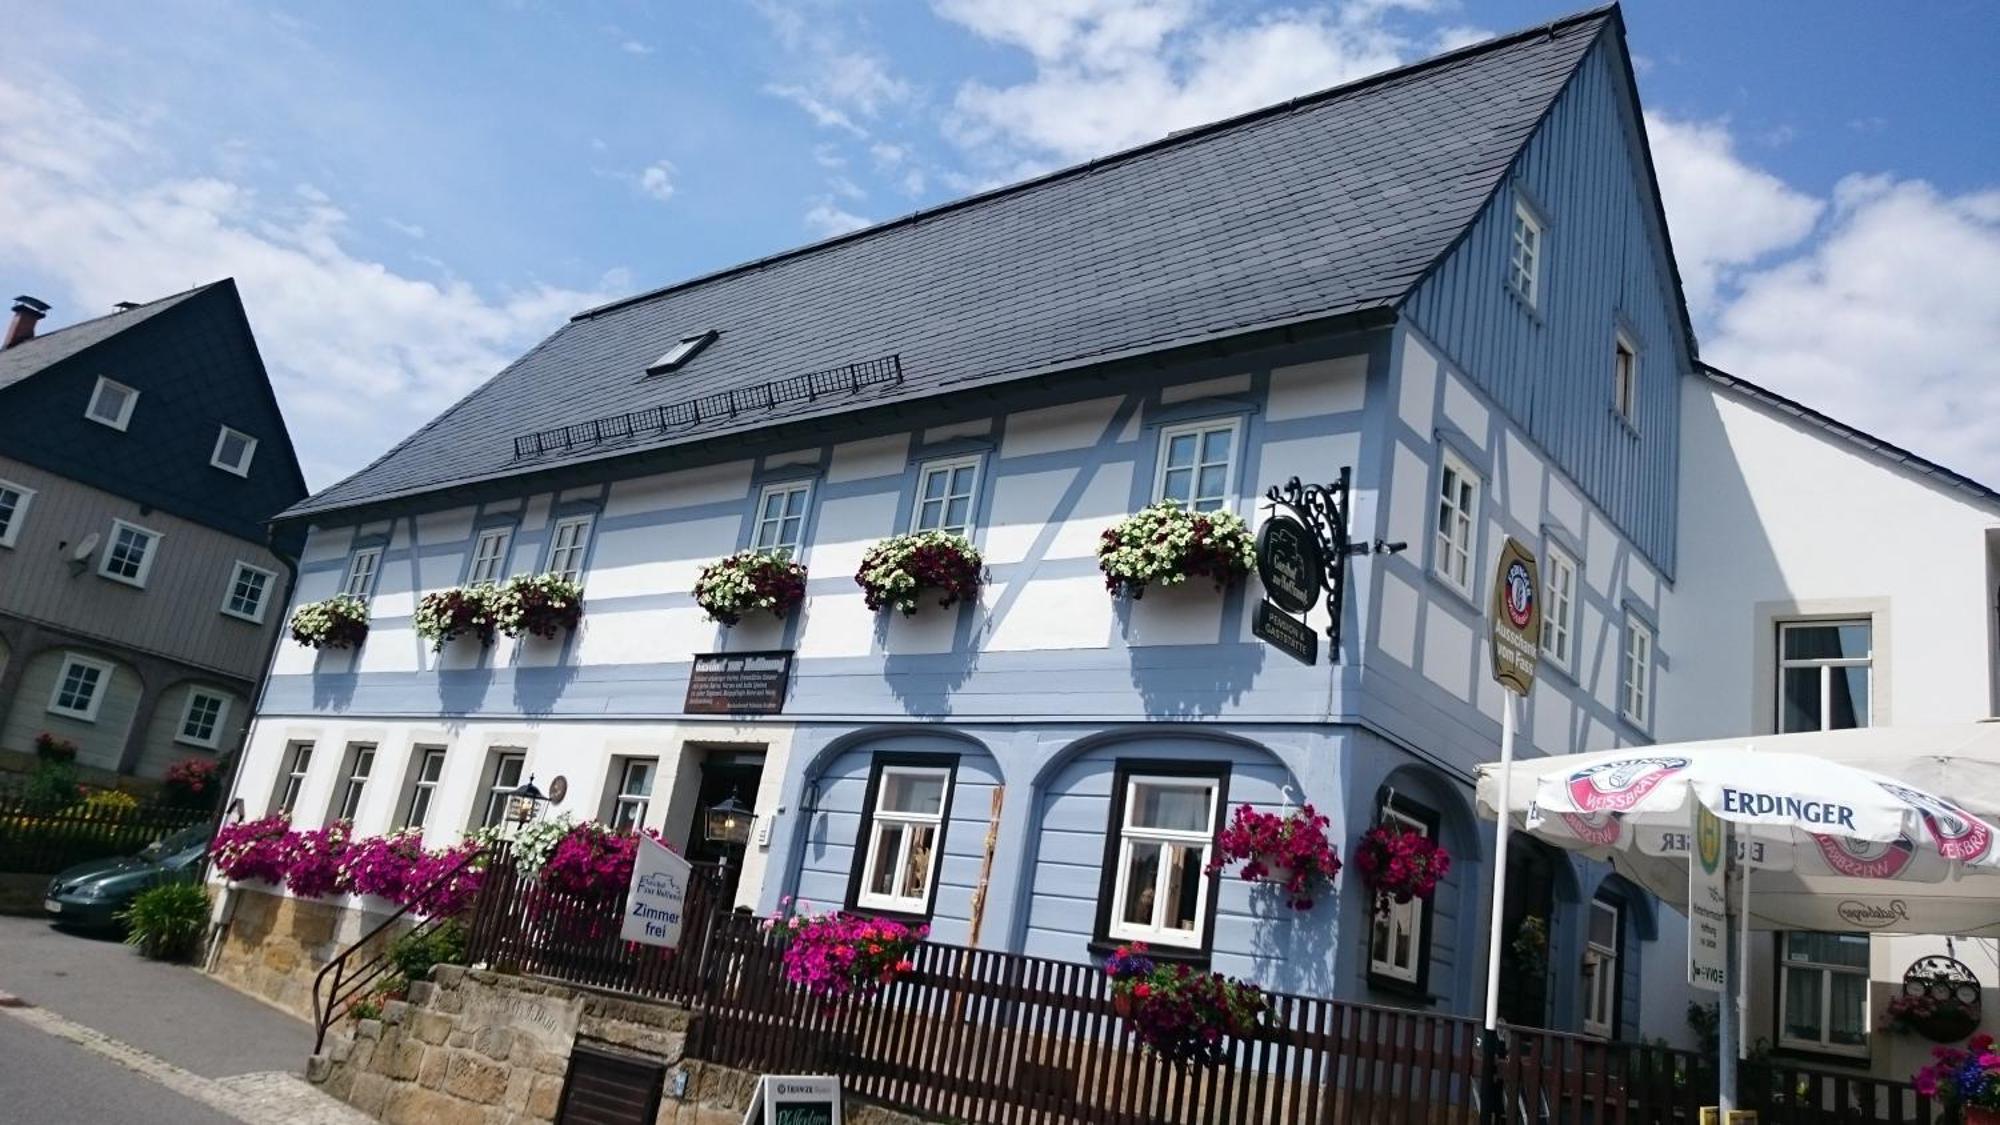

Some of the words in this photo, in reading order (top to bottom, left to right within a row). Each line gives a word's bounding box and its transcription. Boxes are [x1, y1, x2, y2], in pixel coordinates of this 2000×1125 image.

[1495, 618, 1537, 659] Ausschank
[1496, 642, 1514, 664] vom
[1514, 650, 1534, 676] Fass
[1723, 788, 1856, 831] ERDINGER
[633, 902, 679, 924] Zimmer
[646, 921, 666, 938] frei
